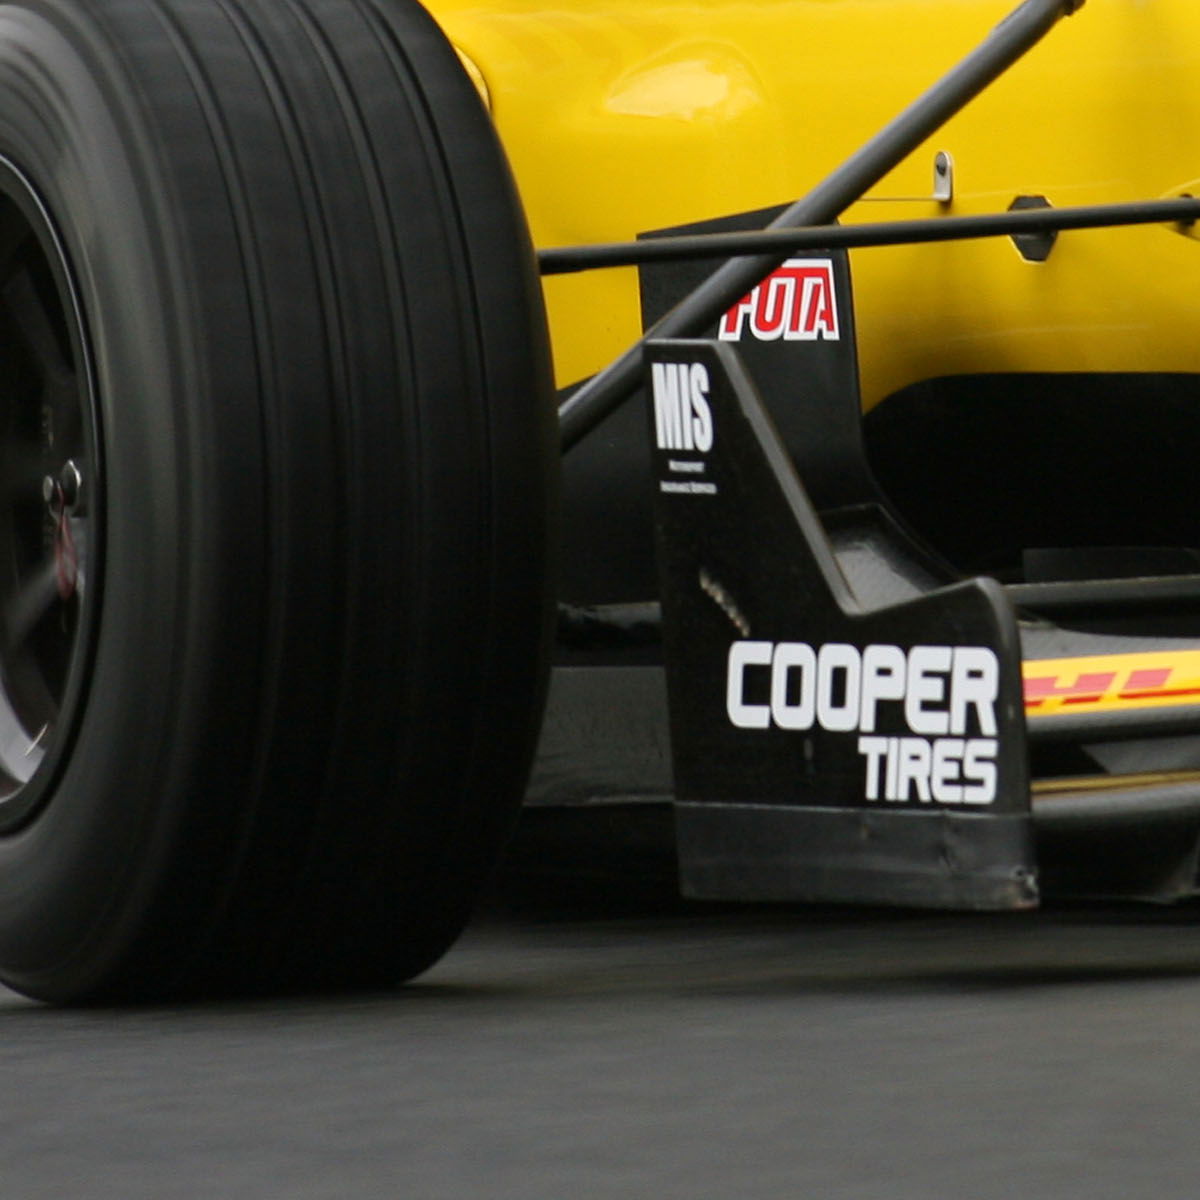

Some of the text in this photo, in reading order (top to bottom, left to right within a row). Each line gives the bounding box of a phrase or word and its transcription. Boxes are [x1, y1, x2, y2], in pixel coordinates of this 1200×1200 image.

[652, 362, 713, 452] MIS
[727, 641, 998, 736] COOPER
[858, 737, 998, 804] TIRES
